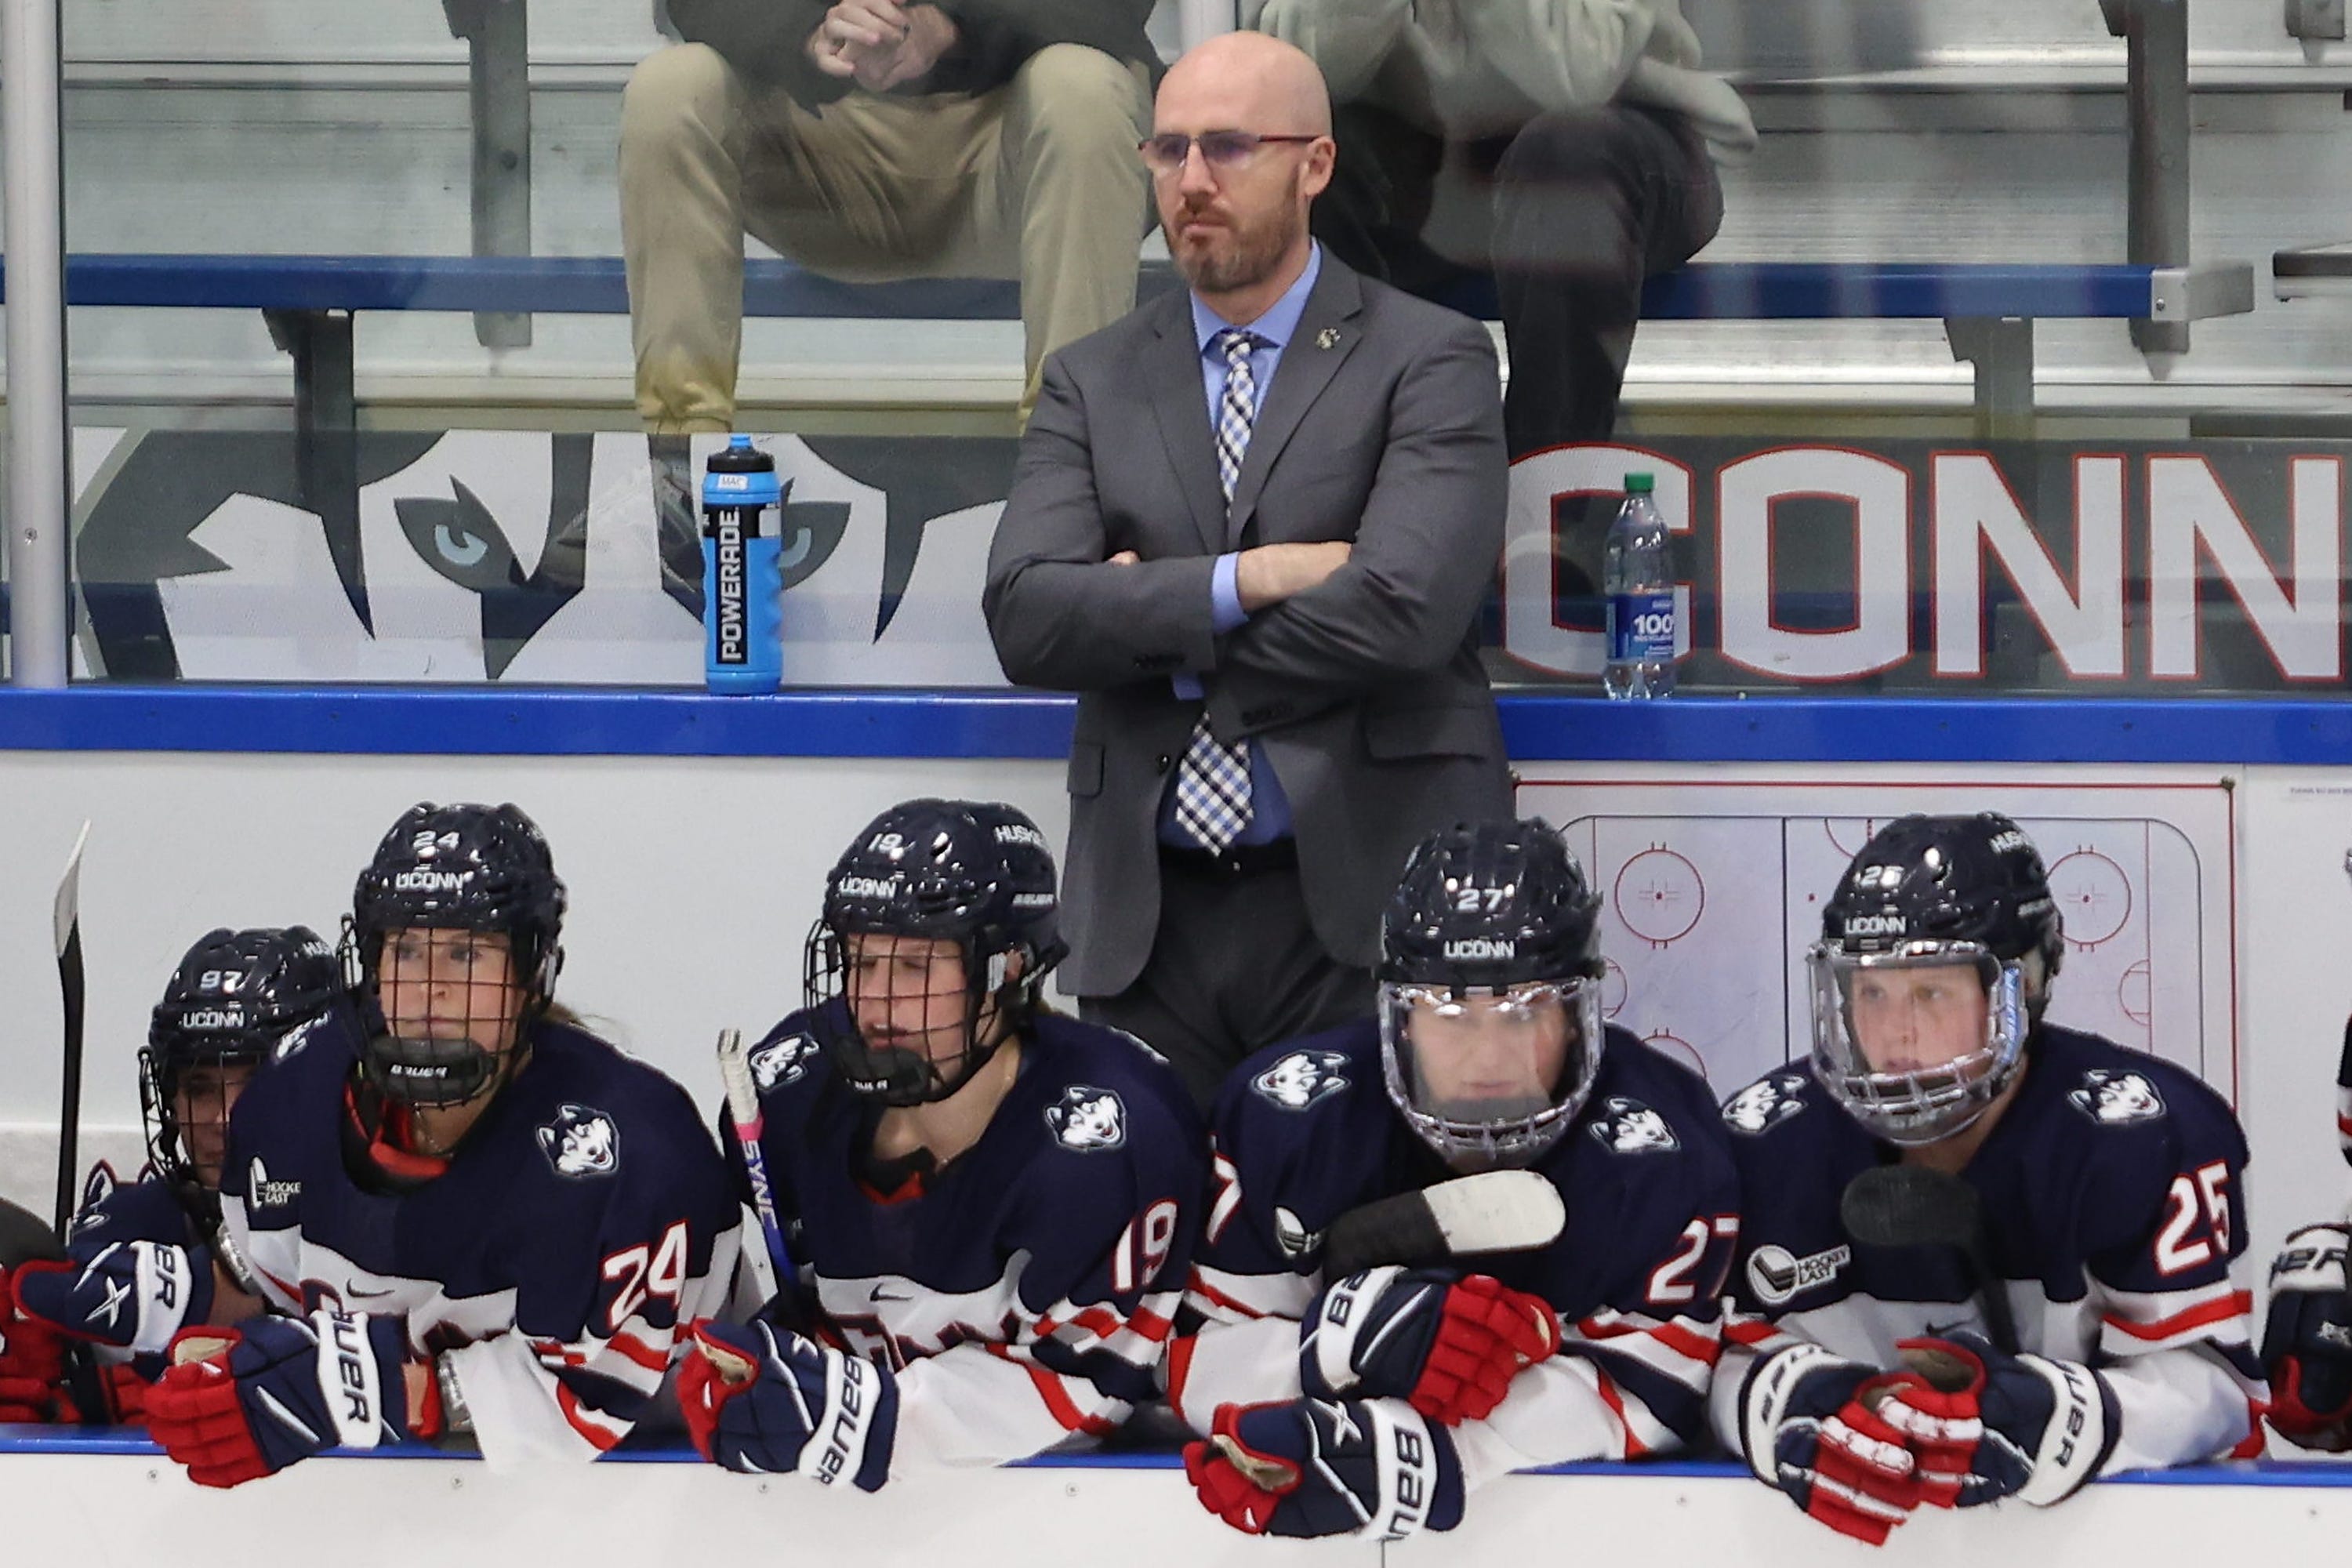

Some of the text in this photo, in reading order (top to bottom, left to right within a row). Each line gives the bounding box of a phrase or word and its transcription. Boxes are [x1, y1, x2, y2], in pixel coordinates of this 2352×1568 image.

[720, 508, 742, 661] POWERADE
[1633, 614, 1672, 634] 100
[413, 830, 459, 850] 24
[868, 833, 903, 855] 19
[395, 872, 464, 891] UCONN
[839, 877, 897, 899] UCONN
[1457, 887, 1504, 913] 27
[1845, 916, 1906, 935] UCONN
[1444, 939, 1515, 960] UCONN
[201, 971, 242, 990] 97
[183, 1011, 245, 1028] UCONN
[2152, 1159, 2230, 1277] 25
[1110, 1197, 1180, 1294] 19
[1644, 1214, 1741, 1304] 27
[602, 1218, 689, 1330] 24
[813, 1356, 862, 1484] BAUER
